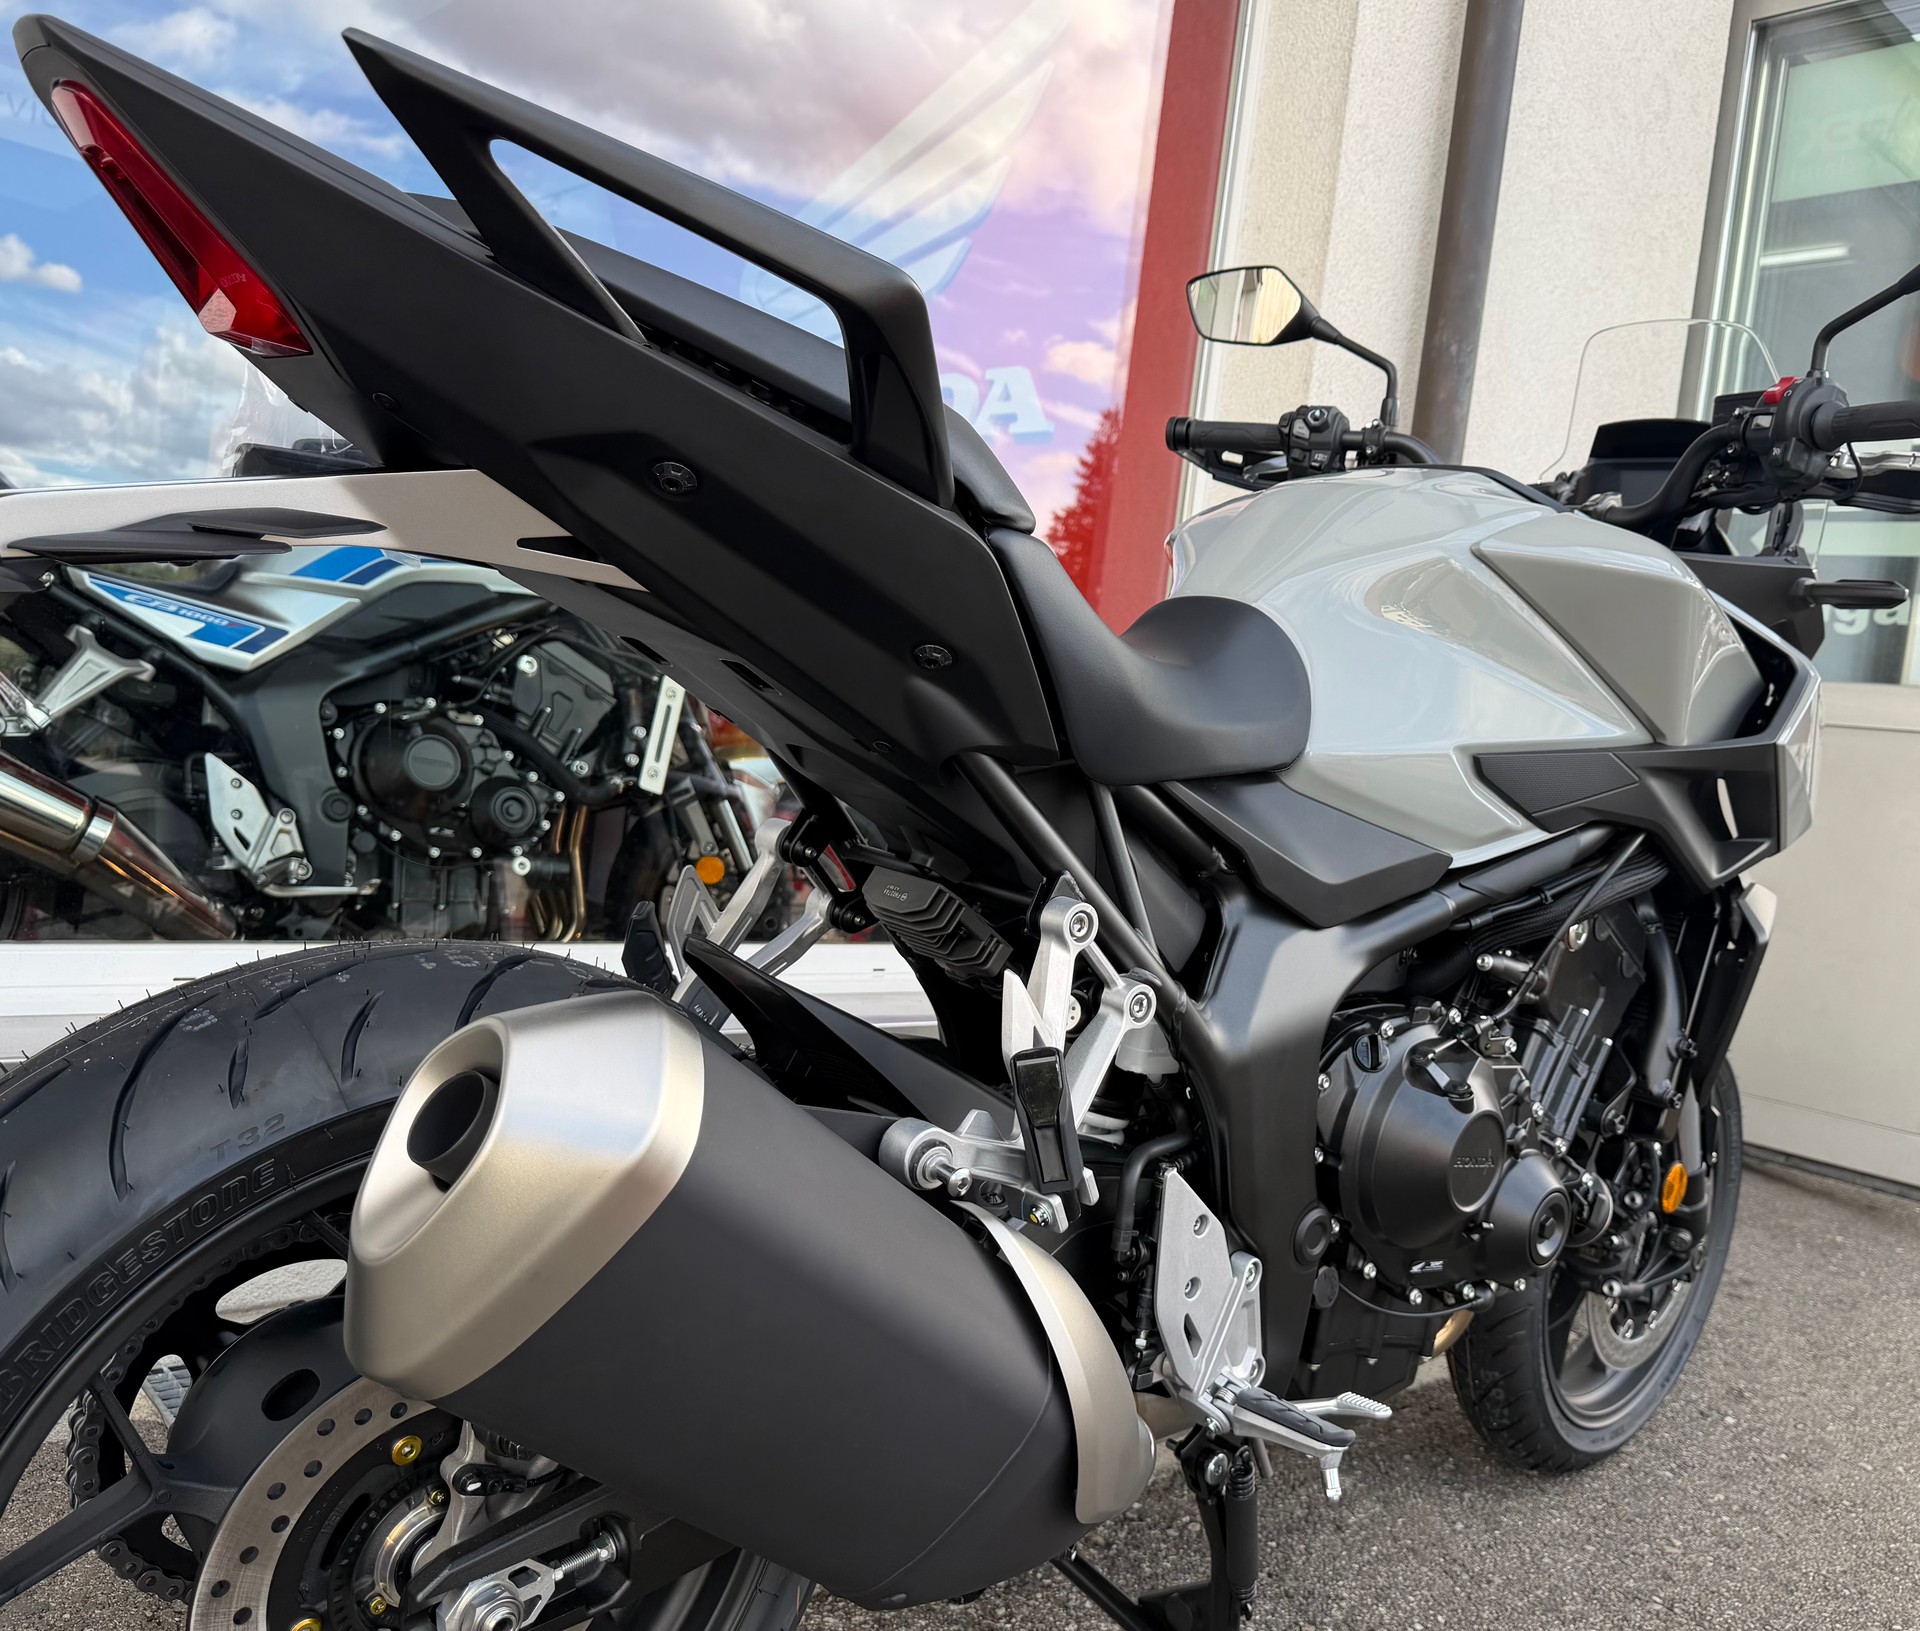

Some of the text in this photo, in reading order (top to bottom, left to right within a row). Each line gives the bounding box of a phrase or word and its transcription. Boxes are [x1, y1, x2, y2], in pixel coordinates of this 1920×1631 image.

[209, 1113, 286, 1161] T32
[1453, 1156, 1495, 1168] HONDA
[0, 1158, 276, 1415] BRIDGESTONE
